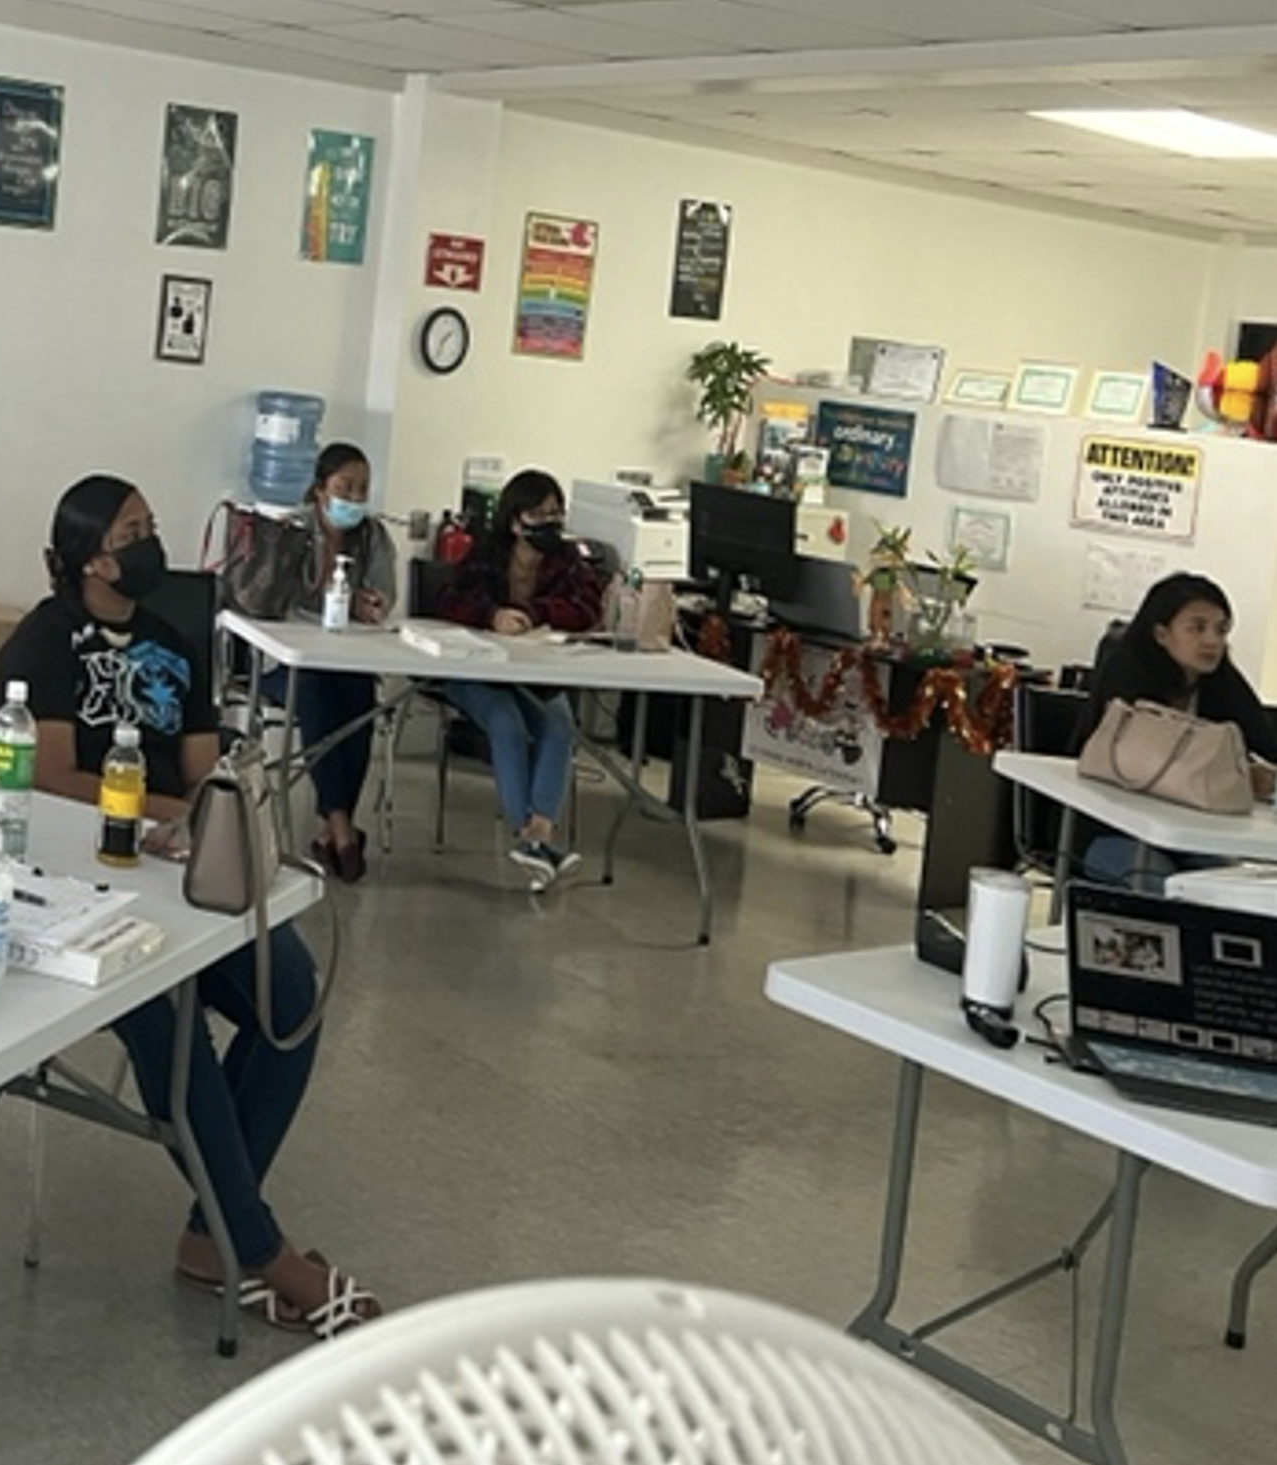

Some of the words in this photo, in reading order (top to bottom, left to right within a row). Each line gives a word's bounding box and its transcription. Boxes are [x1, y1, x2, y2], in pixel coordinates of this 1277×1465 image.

[1086, 442, 1195, 477] ATTENTION!
[1091, 470, 1124, 484] ONLY
[1127, 475, 1182, 493] POSITIVE
[1097, 498, 1154, 513] ALLOWED
[1101, 510, 1129, 522] THIS
[1131, 515, 1165, 529] AREA
